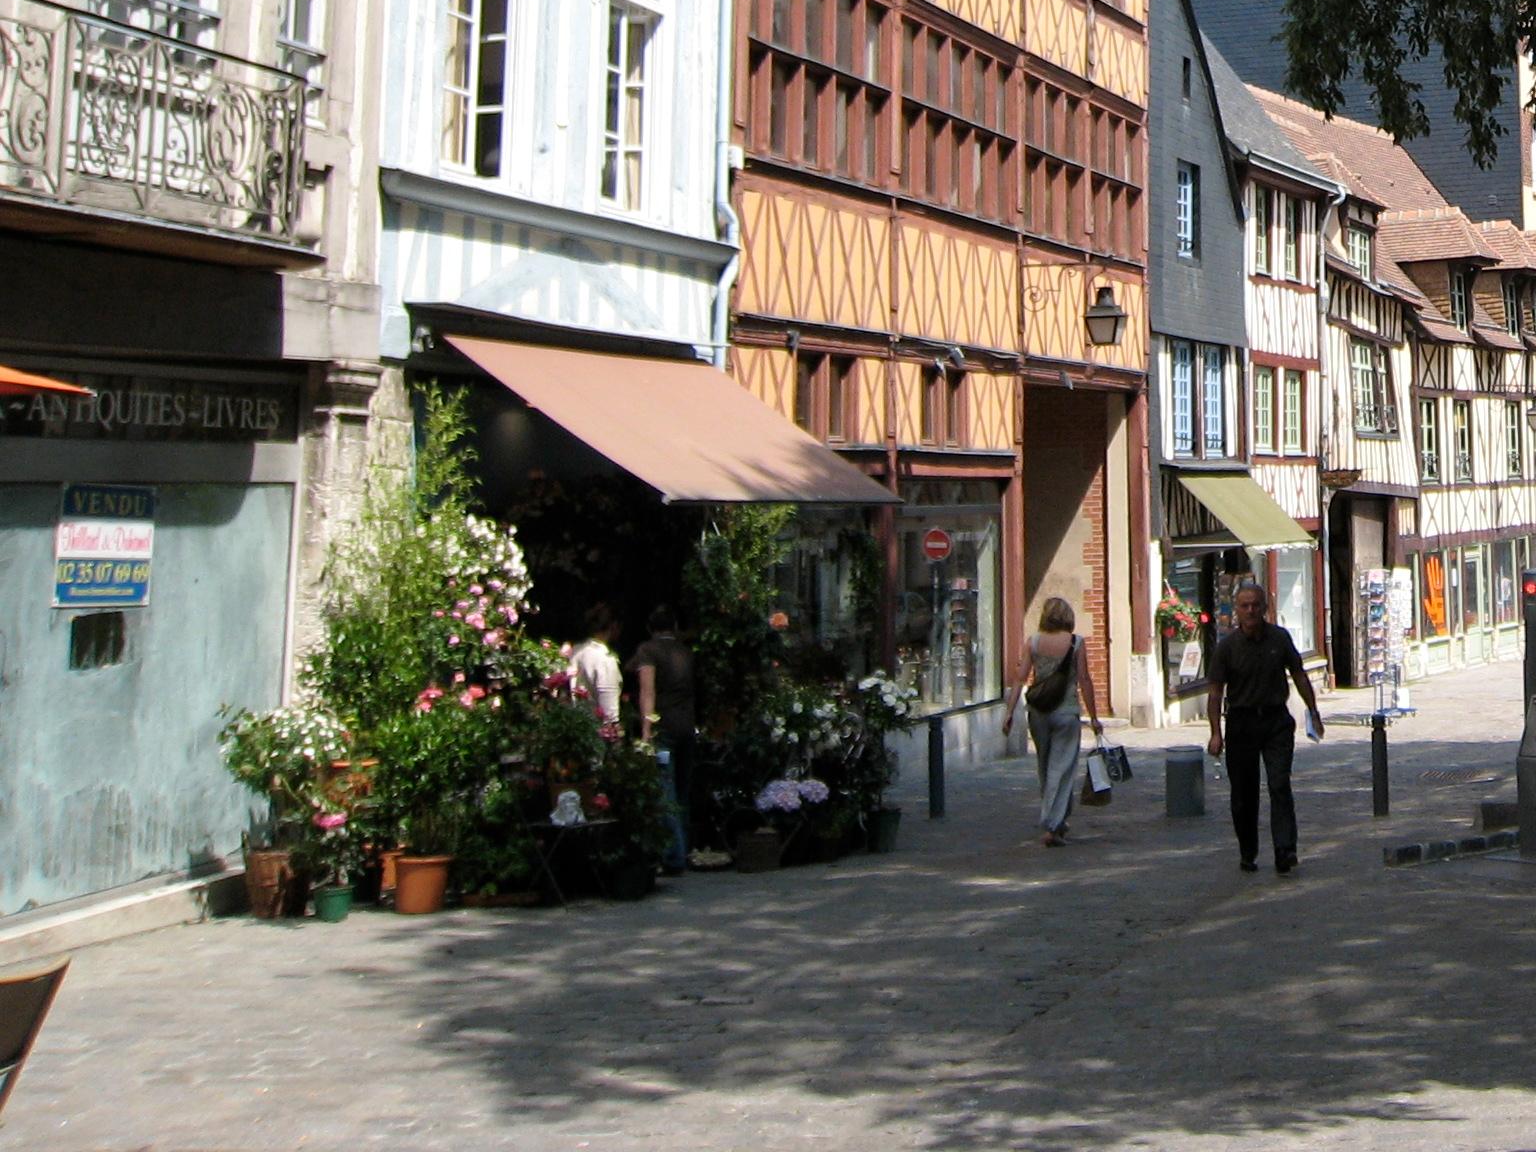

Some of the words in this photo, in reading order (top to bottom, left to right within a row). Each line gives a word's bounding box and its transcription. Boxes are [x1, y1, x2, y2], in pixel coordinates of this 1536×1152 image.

[73, 491, 148, 517] VENDU
[76, 561, 95, 584] 35
[95, 561, 114, 584] 07
